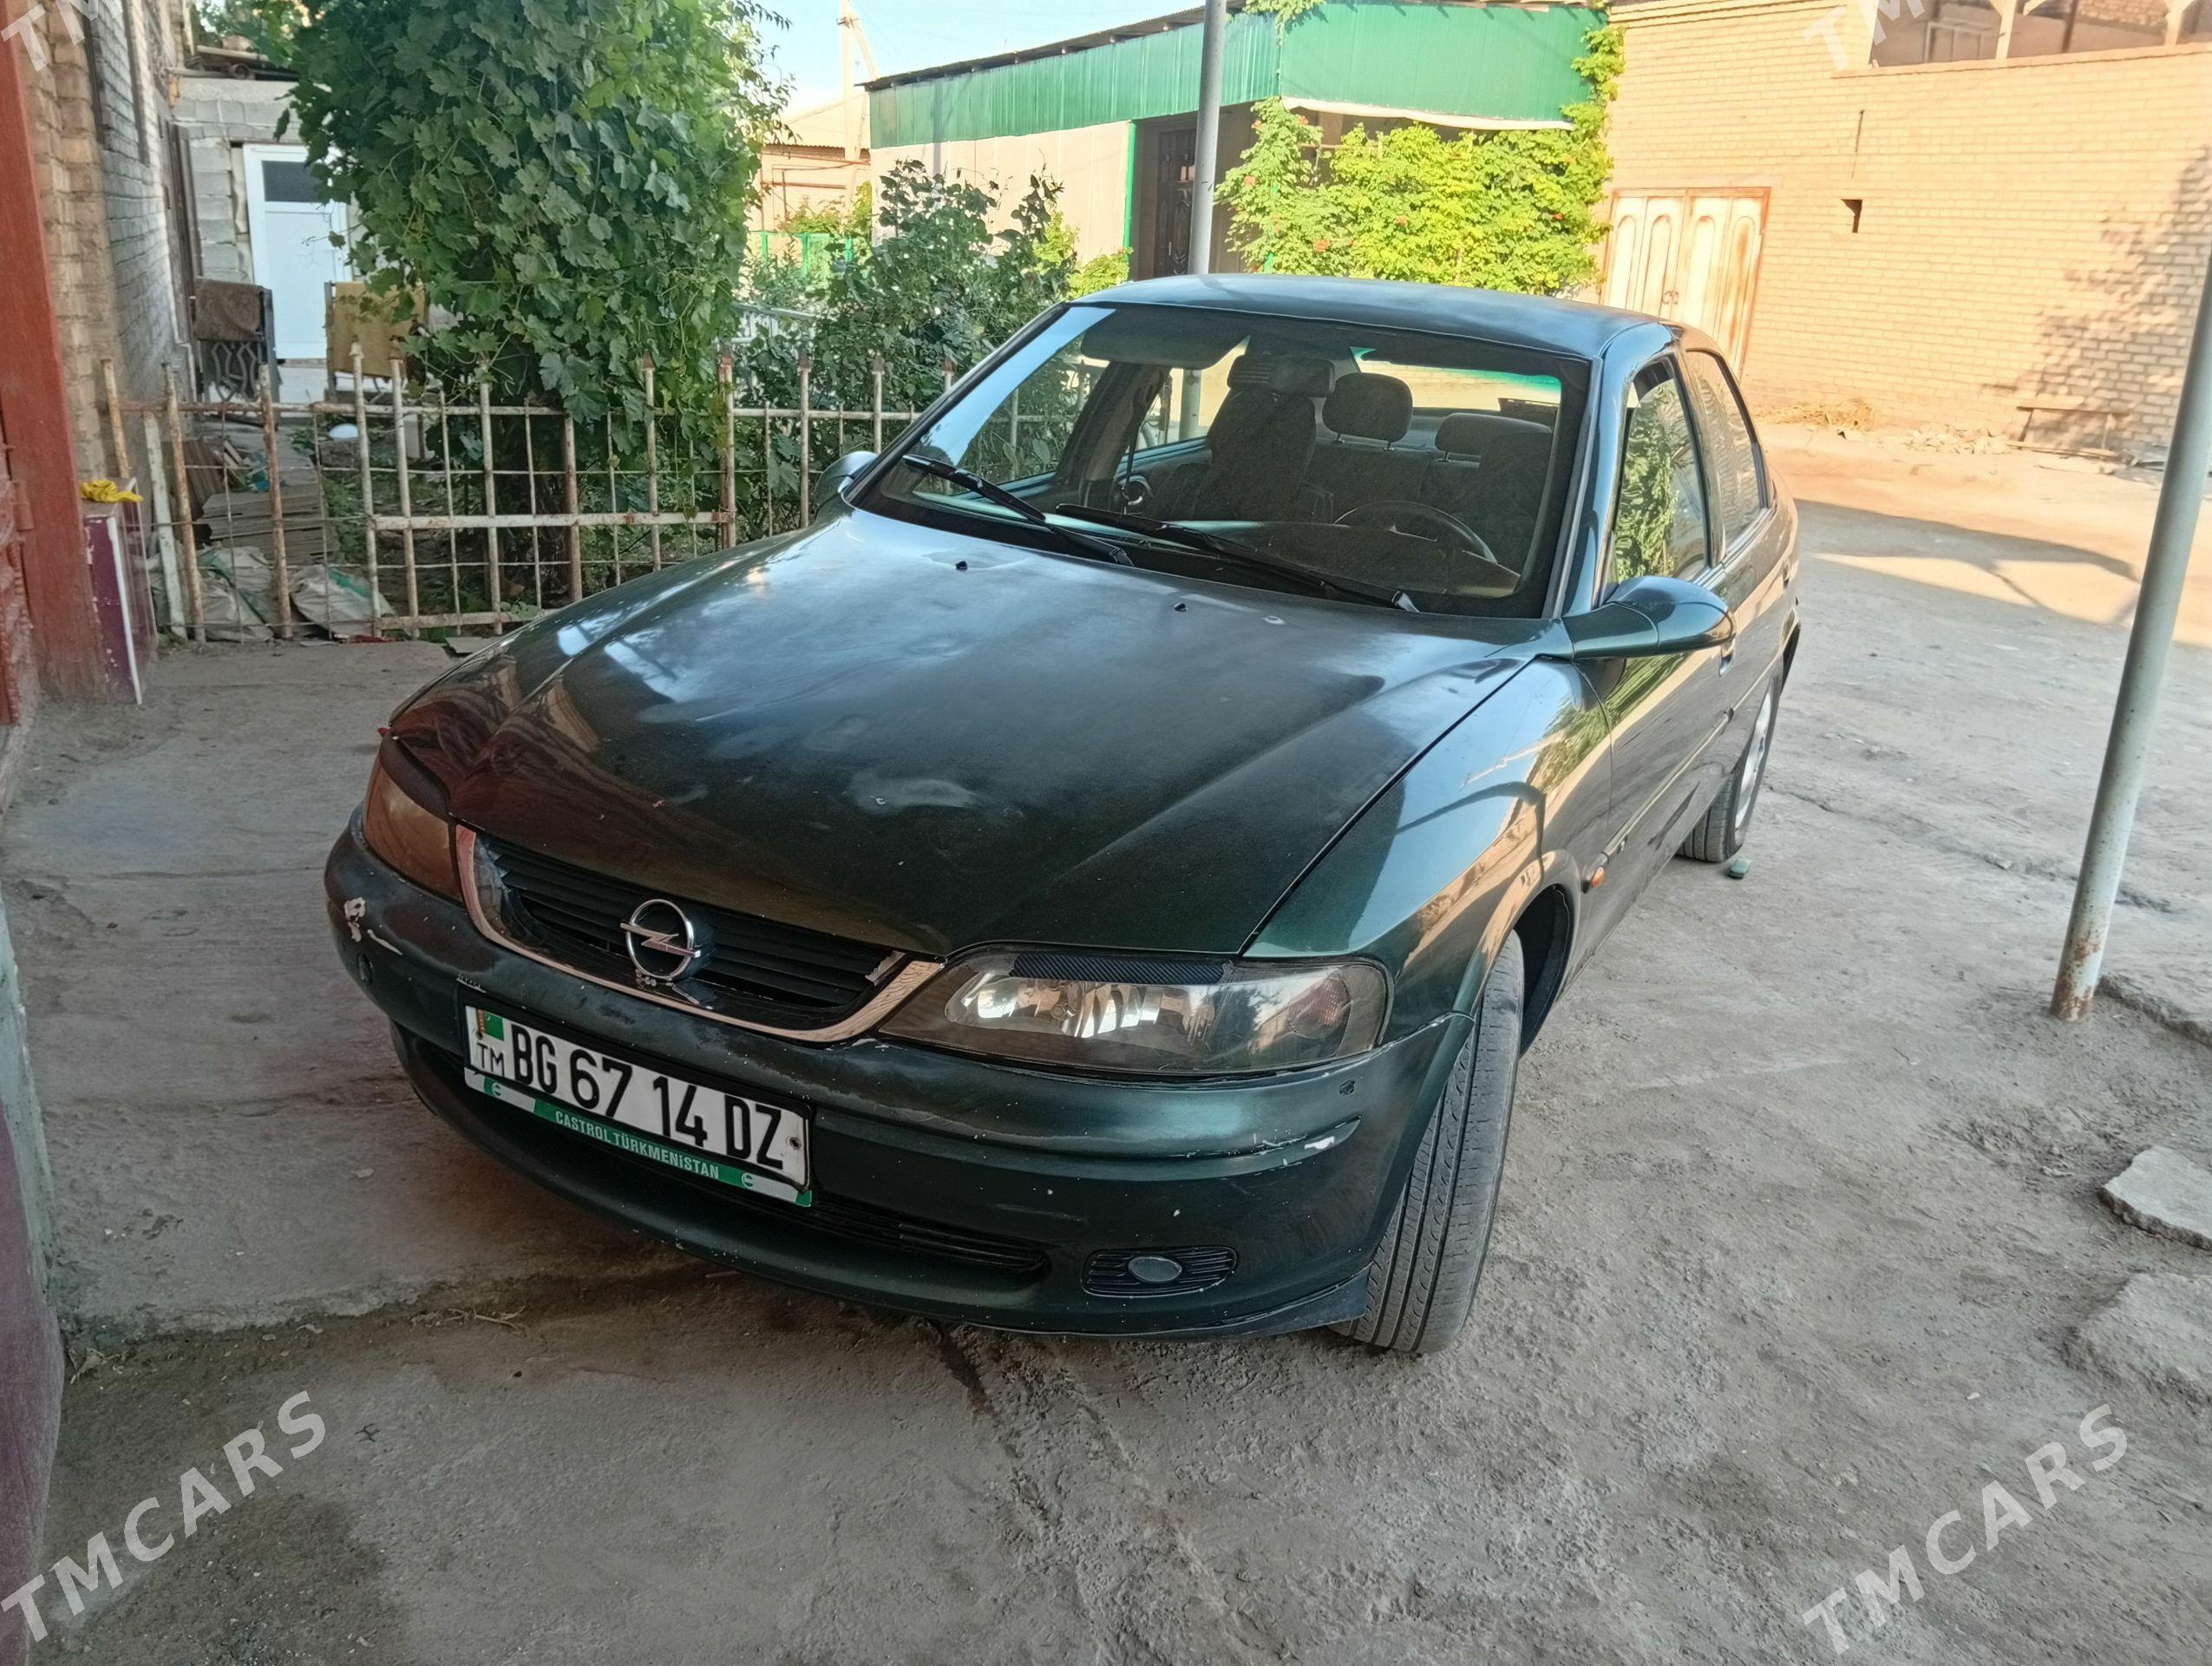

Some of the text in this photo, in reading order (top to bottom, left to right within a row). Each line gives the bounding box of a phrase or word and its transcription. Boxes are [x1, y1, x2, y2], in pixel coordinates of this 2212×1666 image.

[477, 1042, 506, 1078] TM
[511, 1024, 783, 1171] BG 67 14 DZ
[553, 1110, 611, 1144] CASTROL
